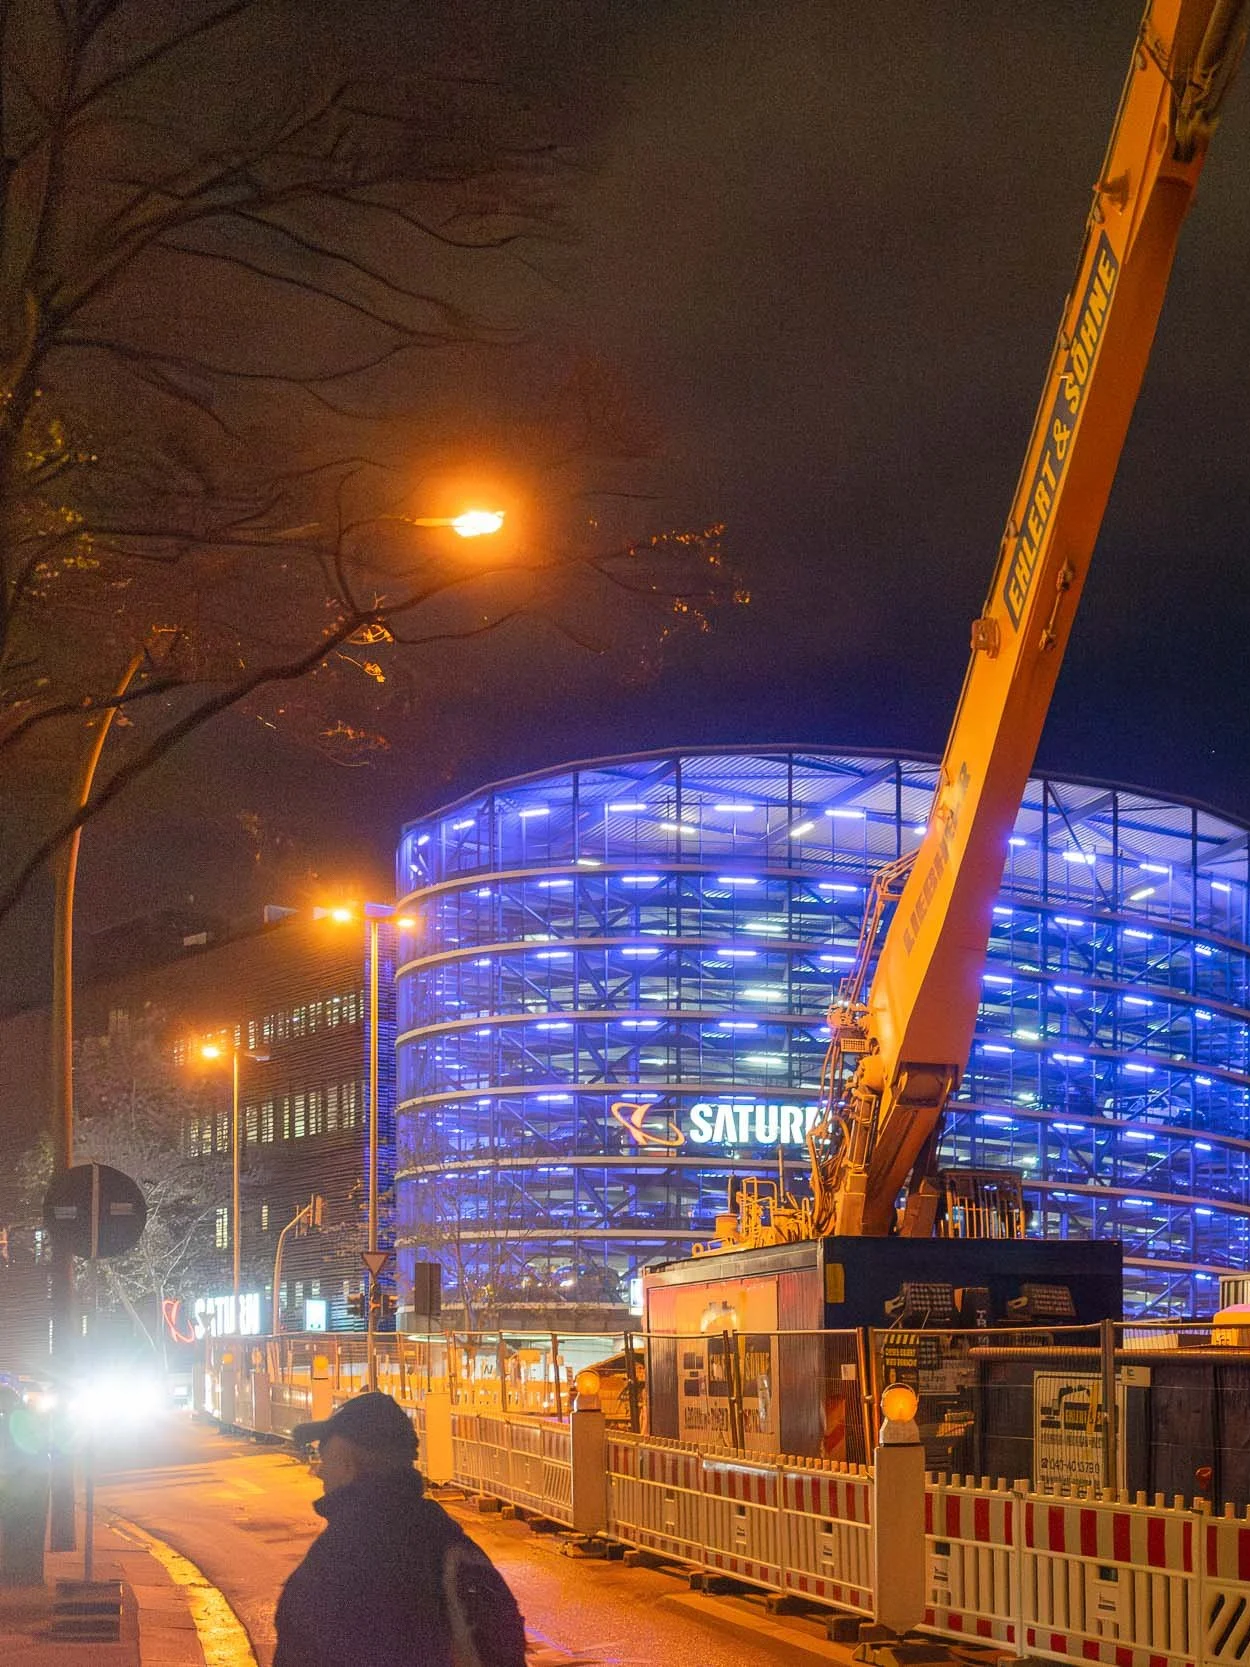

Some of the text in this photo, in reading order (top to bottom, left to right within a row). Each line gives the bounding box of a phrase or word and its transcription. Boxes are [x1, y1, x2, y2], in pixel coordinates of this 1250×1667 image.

[1009, 249, 1115, 619] EHLERT & SÖHNE
